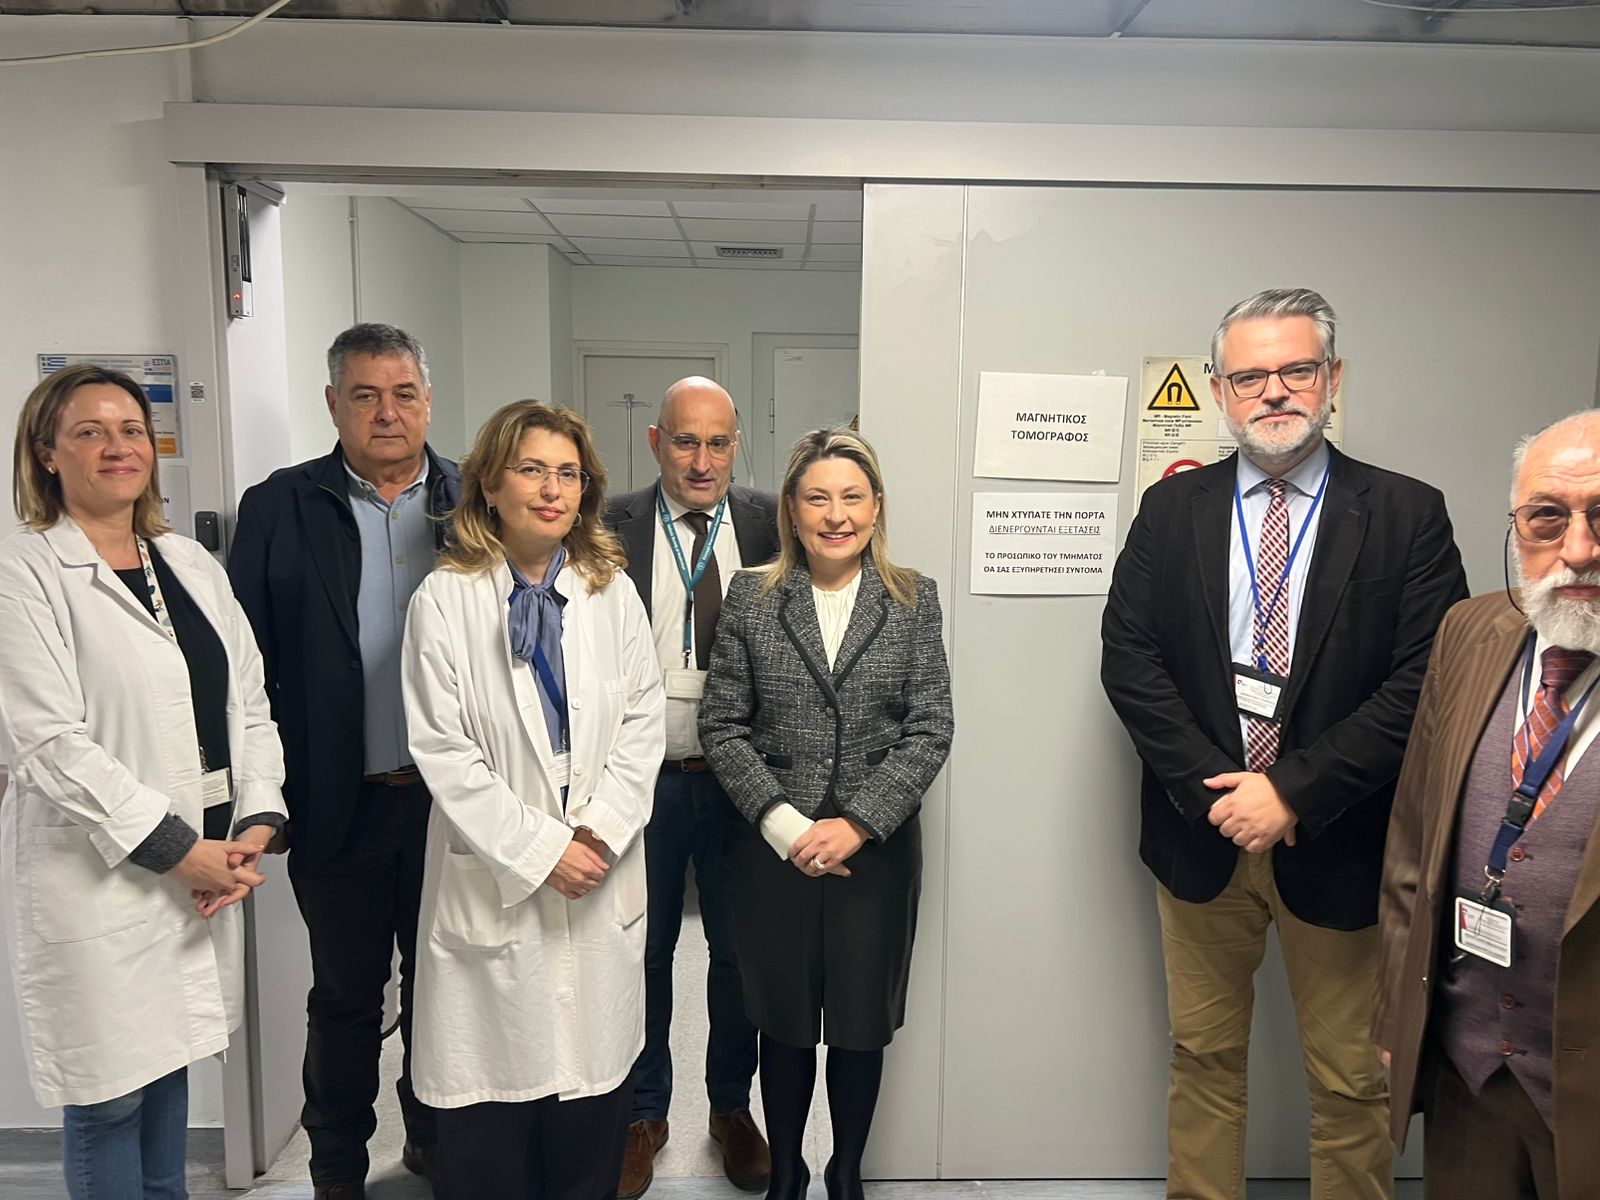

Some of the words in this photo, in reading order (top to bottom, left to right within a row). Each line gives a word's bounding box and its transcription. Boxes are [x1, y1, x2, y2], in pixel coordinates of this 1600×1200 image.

[1016, 412, 1087, 424] ΜΑΓΝΗΤΙΚΟΣ
[1011, 430, 1089, 442] ΤΟΜΟΓΡΑΦΟΣ
[986, 511, 1009, 519] ΜΗΝ
[1011, 511, 1052, 519] ΧΤΥΠΑΤΕ
[1054, 511, 1072, 519] ΤΗΝ
[1074, 511, 1105, 520] ΠΟΡΤΑ
[989, 525, 1056, 534] ΔΙΕΝΕΡΓΟΥΝΤΑΙ
[1059, 526, 1101, 534] ΕΞΕΤΑΣΕΙΣ
[1012, 566, 1064, 574] ΕΞΥΠΗΡΕΤΗΣΕΙ
[1066, 566, 1103, 574] ΣΥΝΤΟΜΑ
